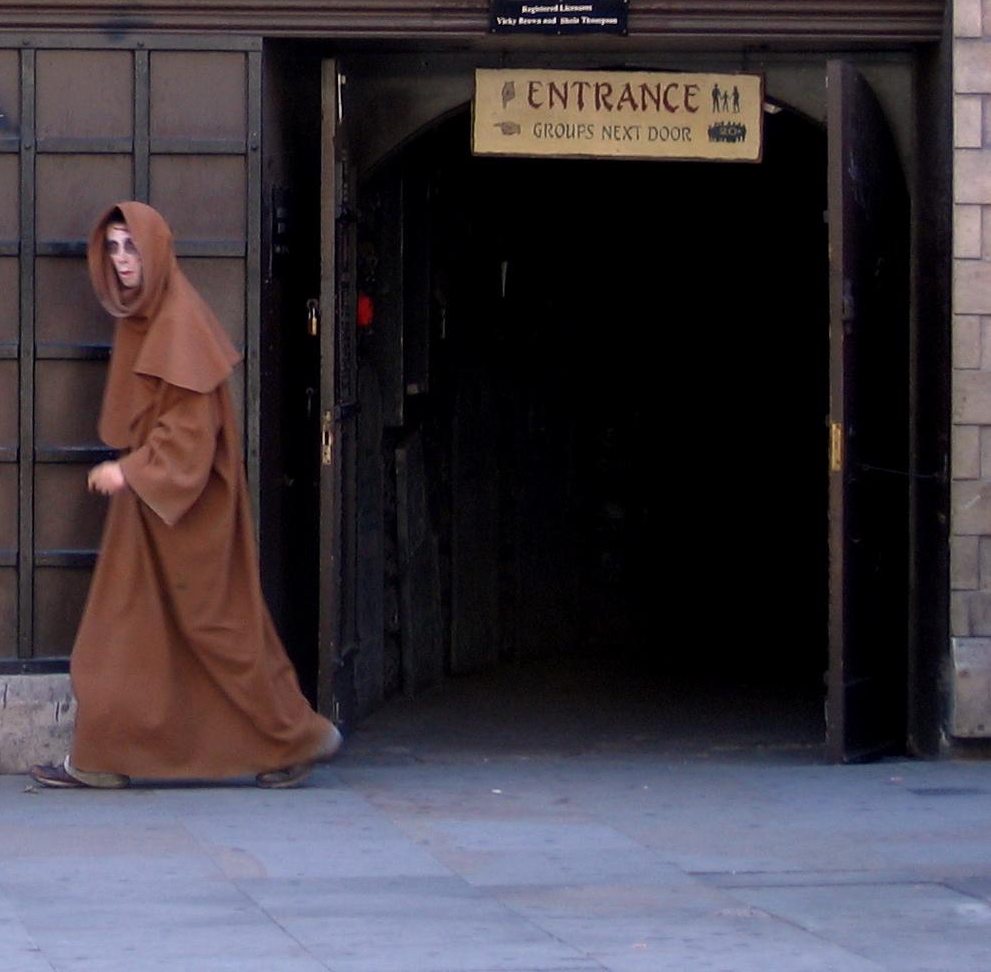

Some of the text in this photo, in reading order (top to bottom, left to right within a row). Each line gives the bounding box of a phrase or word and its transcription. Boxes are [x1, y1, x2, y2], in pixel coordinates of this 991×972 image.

[496, 16, 517, 26] Vicky
[518, 16, 542, 25] Brown
[543, 16, 557, 25] and
[580, 16, 618, 27] Thompson
[527, 81, 701, 113] ENTRANCE
[533, 123, 693, 143] GROUPS NEXT DOOR
